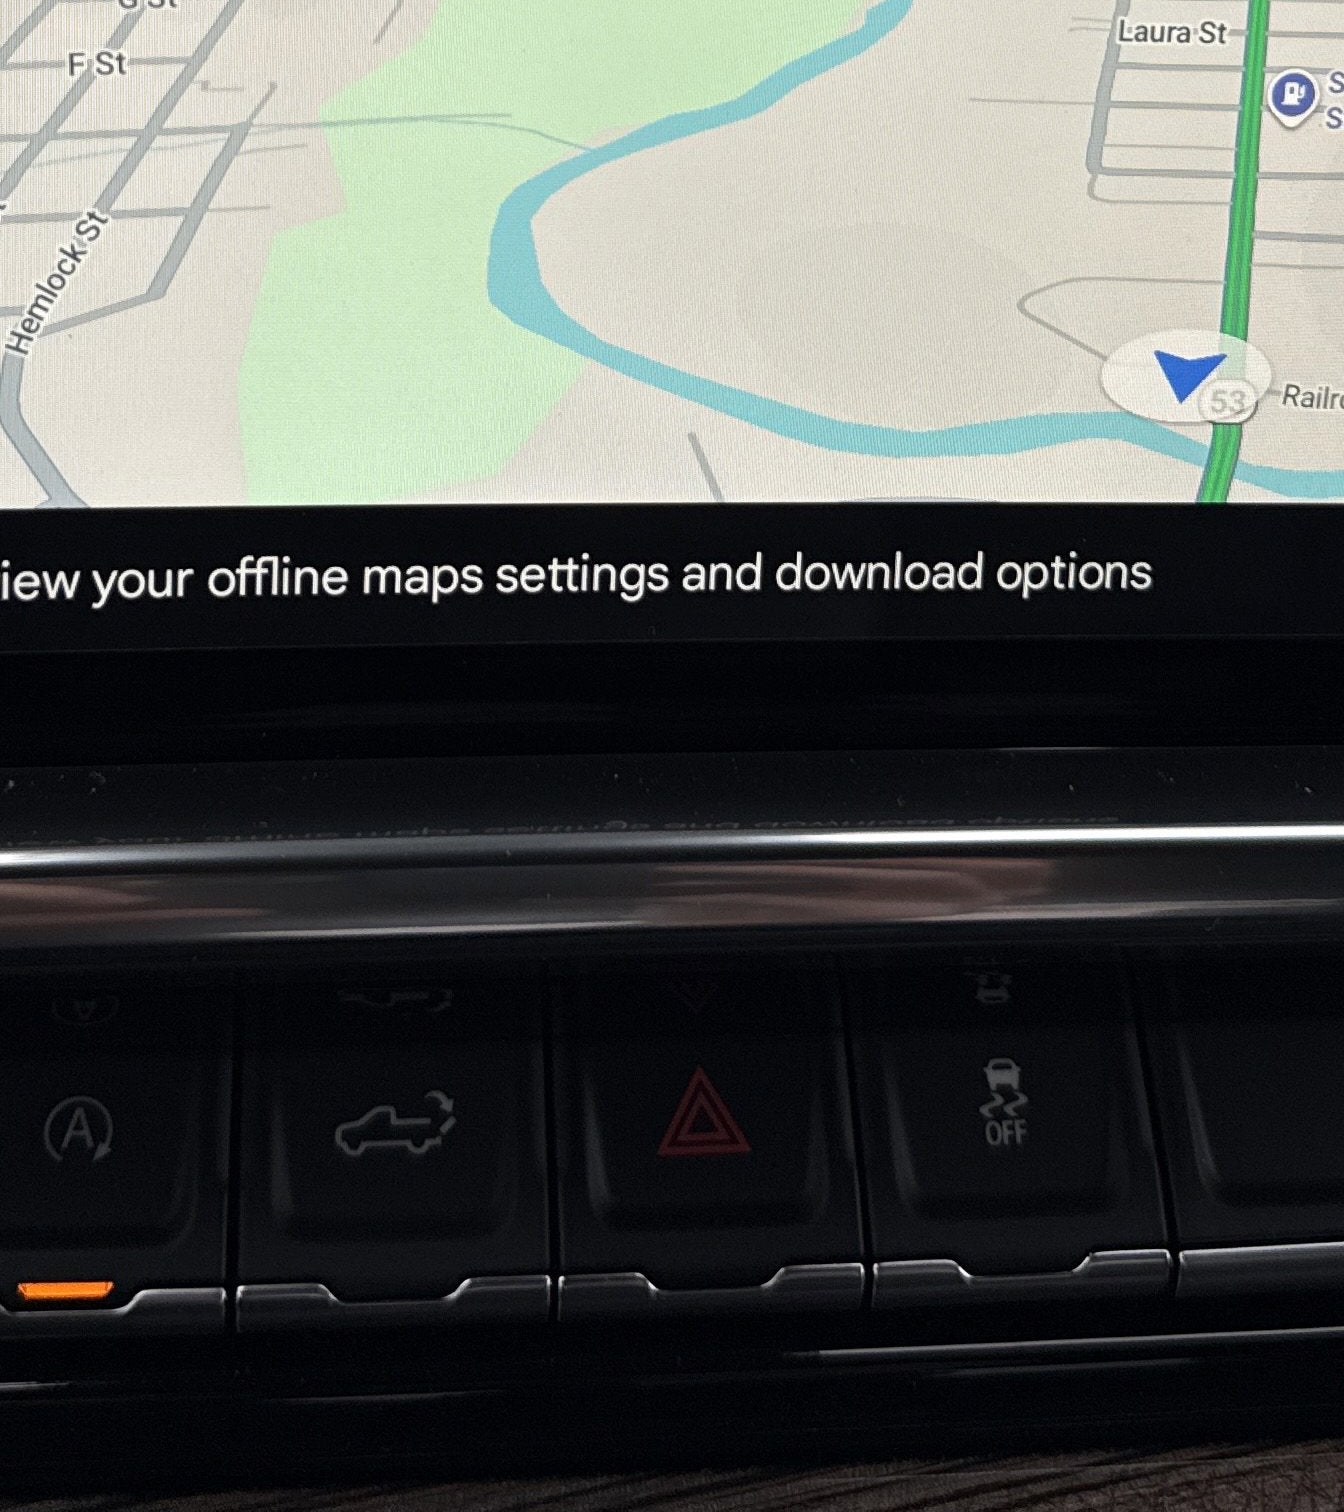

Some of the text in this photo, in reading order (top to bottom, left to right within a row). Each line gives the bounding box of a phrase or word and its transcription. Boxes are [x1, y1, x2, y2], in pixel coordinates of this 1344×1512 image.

[1118, 20, 1227, 45] Laura St
[68, 51, 126, 76] F St
[5, 210, 109, 355] Hemlock St
[1210, 390, 1245, 412] 53
[91, 562, 194, 609] your
[208, 555, 349, 598] offline
[363, 560, 483, 604] maps
[496, 552, 670, 602] settings
[682, 552, 762, 593] and
[775, 550, 984, 593] download
[996, 553, 1153, 599] options
[985, 1118, 1027, 1146] OFF
